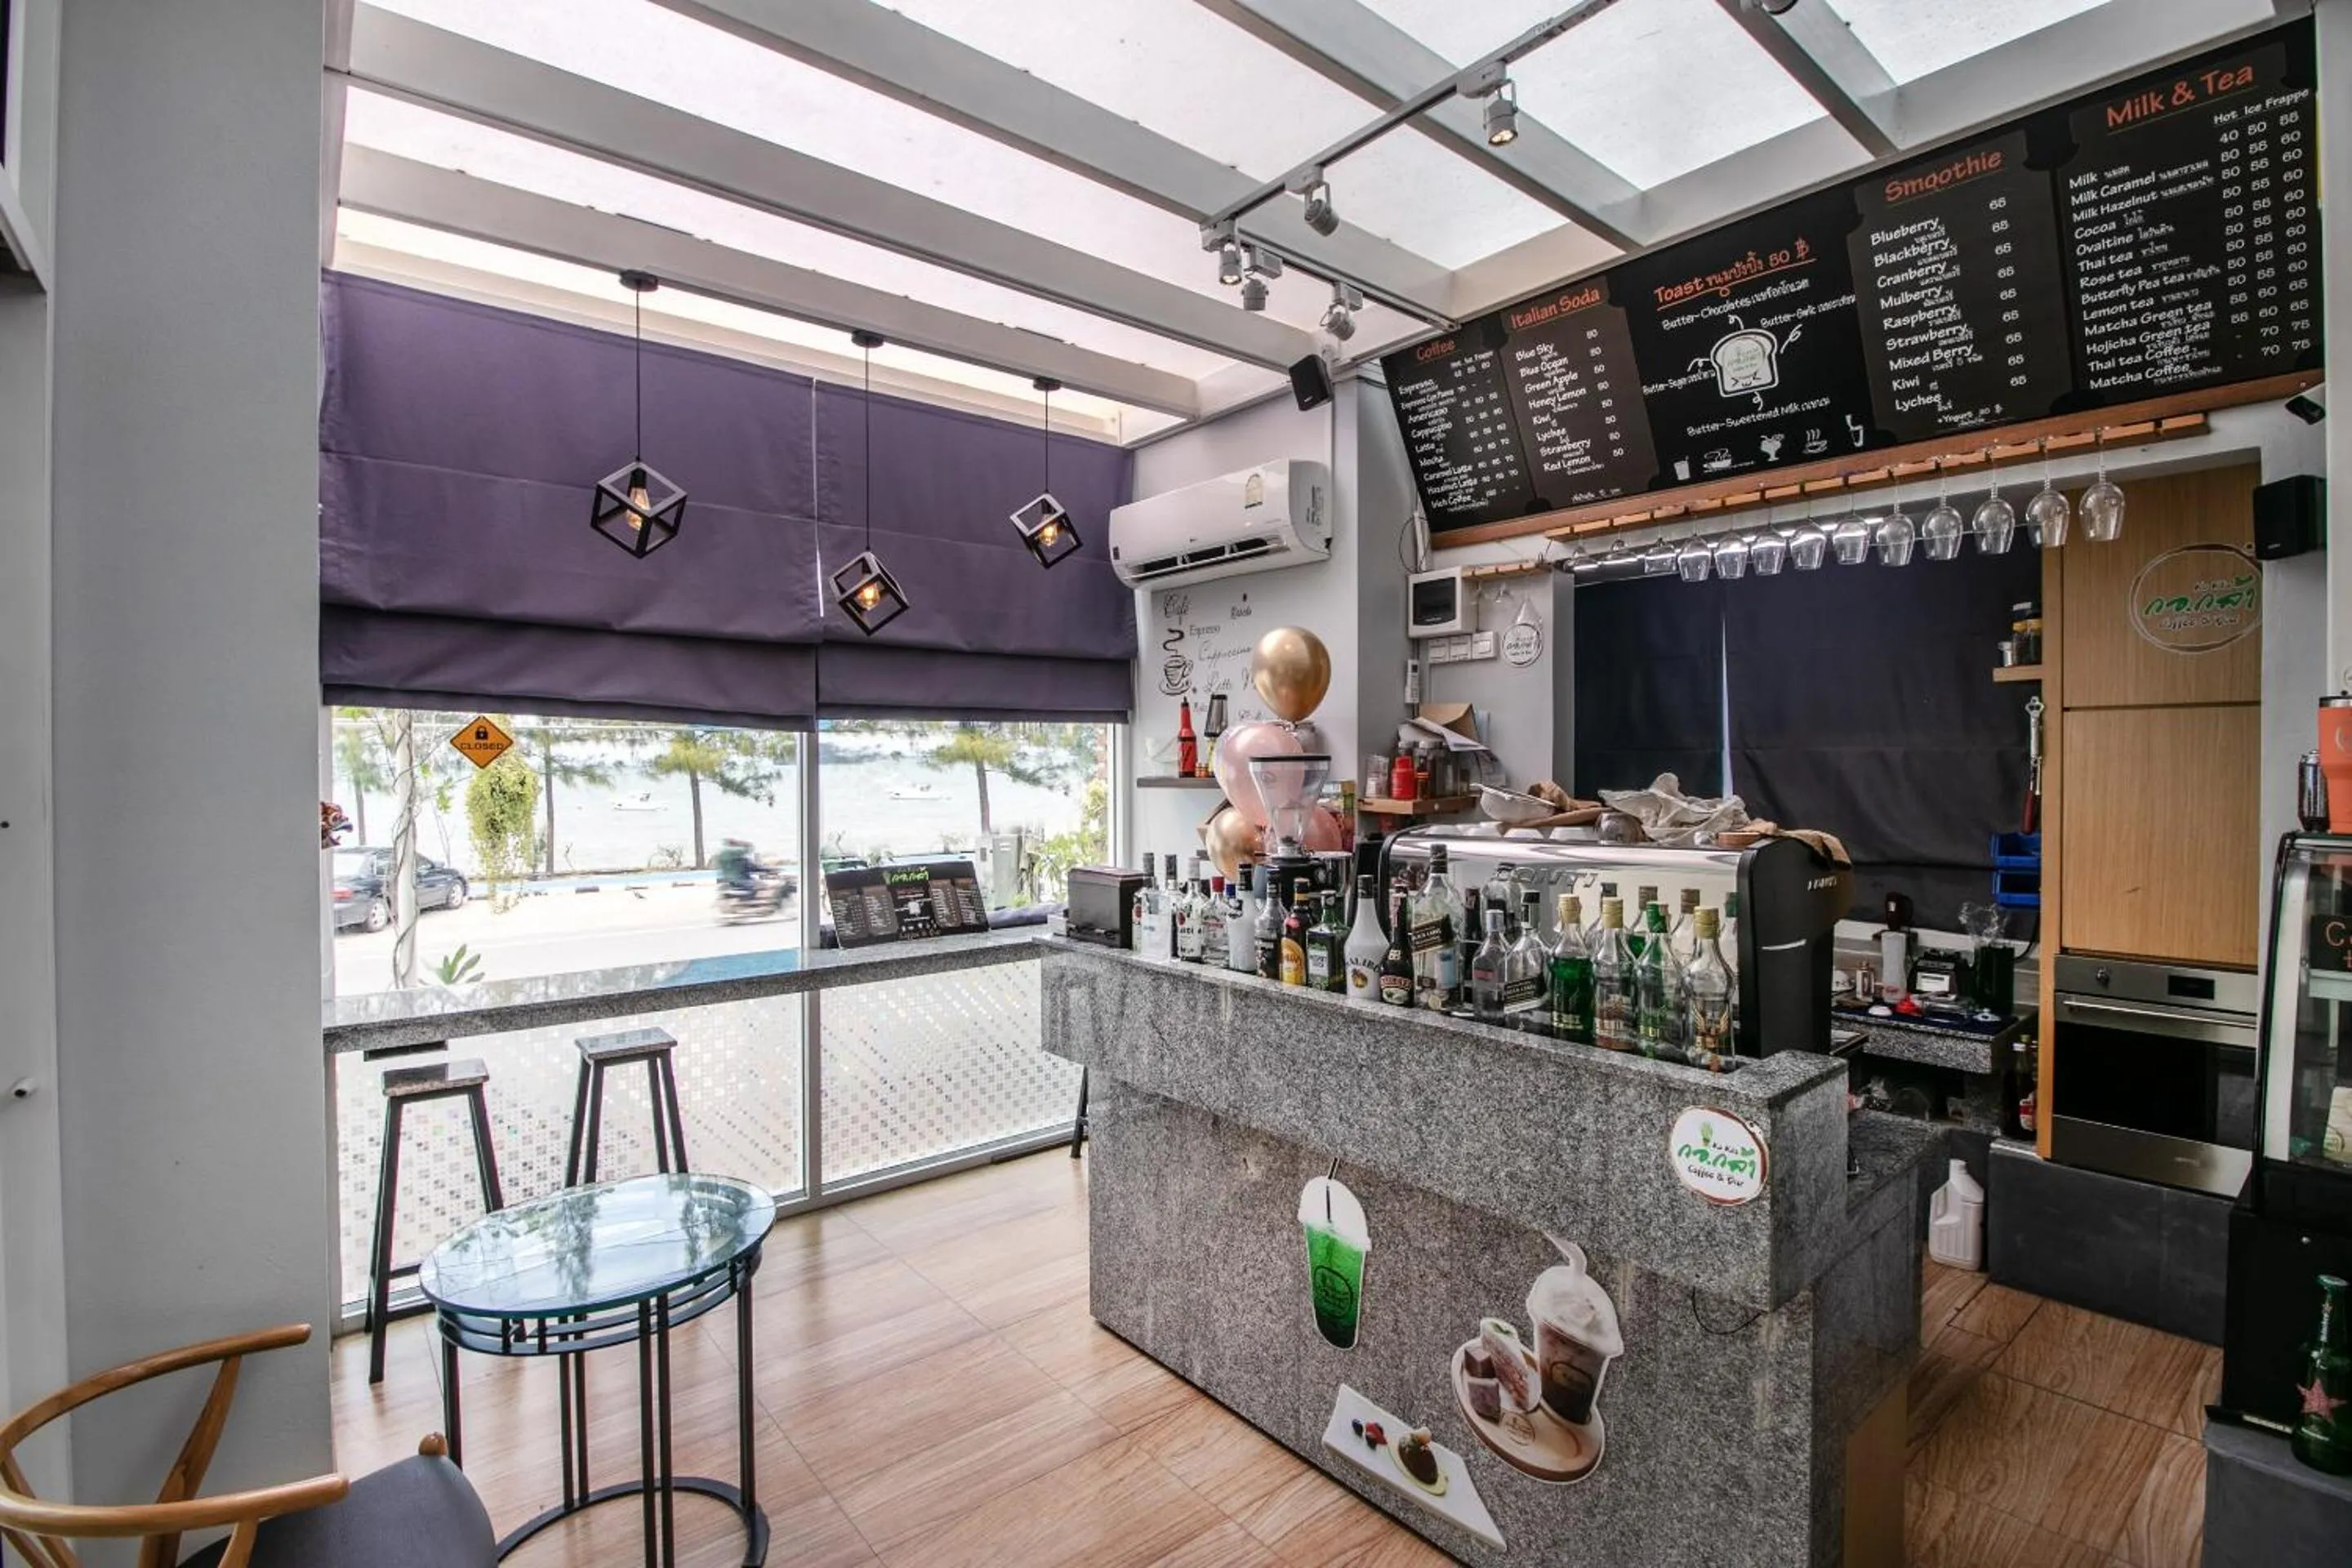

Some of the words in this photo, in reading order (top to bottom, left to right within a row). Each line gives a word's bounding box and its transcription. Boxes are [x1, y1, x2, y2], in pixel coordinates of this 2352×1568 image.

[2107, 91, 2165, 128] Milk
[2171, 80, 2196, 107] &
[2199, 65, 2254, 96] Tea
[2212, 110, 2238, 124] Hot
[2244, 104, 2262, 115] Ice
[2265, 87, 2310, 108] Frappe
[2069, 172, 2098, 189] Milk
[2219, 129, 2238, 144] 40
[1886, 151, 2003, 203] Smoothie
[2071, 189, 2098, 206] Milk
[2100, 172, 2155, 198] Caramel
[2073, 207, 2099, 224] Milk
[2100, 190, 2158, 214] Hazelnut
[1870, 217, 1940, 246] Blueberry
[2074, 221, 2117, 239] Cocoa
[1873, 238, 1950, 268] Blackberry
[2075, 234, 2134, 256] Ovaltine
[1877, 261, 1947, 288] Cranberry
[2078, 255, 2106, 273] Thai
[2109, 252, 2133, 266] tea
[1654, 276, 1704, 302] Toast
[2080, 273, 2115, 289] Rose
[2118, 265, 2142, 278] tea
[2081, 283, 2136, 305] Butterfly
[2138, 278, 2160, 292] Pea
[2163, 273, 2185, 286] tea
[1511, 304, 1558, 329] Italian
[1559, 287, 1601, 311] Soda
[1881, 285, 1943, 310] Mulberry
[2082, 304, 2127, 321] Lemon
[2130, 297, 2154, 310] tea
[1882, 305, 1958, 330] Raspberry
[2084, 318, 2138, 337] Matcha
[2140, 307, 2184, 324] Green
[2186, 301, 2212, 313] tea
[1417, 339, 1455, 361] Coffee
[1886, 323, 1968, 351] Strawberry
[2086, 336, 2137, 355] Hojicha
[2139, 327, 2182, 344] Green
[2185, 321, 2211, 334] tea
[1516, 349, 1535, 361] Blue
[1535, 343, 1555, 357] Sky
[1889, 351, 1930, 371] Mixed
[1932, 344, 1974, 362] Berry
[2087, 358, 2116, 372] Thai
[2118, 354, 2143, 368] tea
[2145, 345, 2190, 362] Coffee
[1525, 381, 1552, 394] Green
[1552, 371, 1579, 385] Apple
[1892, 376, 1919, 392] Kiwi
[2089, 372, 2143, 390] Matcha
[2145, 363, 2190, 380] Coffee
[1528, 396, 1557, 411] Honey
[1557, 387, 1587, 402] Lemon
[1895, 394, 1942, 412] Lychee
[1544, 461, 1561, 472] Red
[1561, 456, 1591, 468] Lemon
[461, 742, 504, 751] CLOSED
[2326, 921, 2352, 947] C
